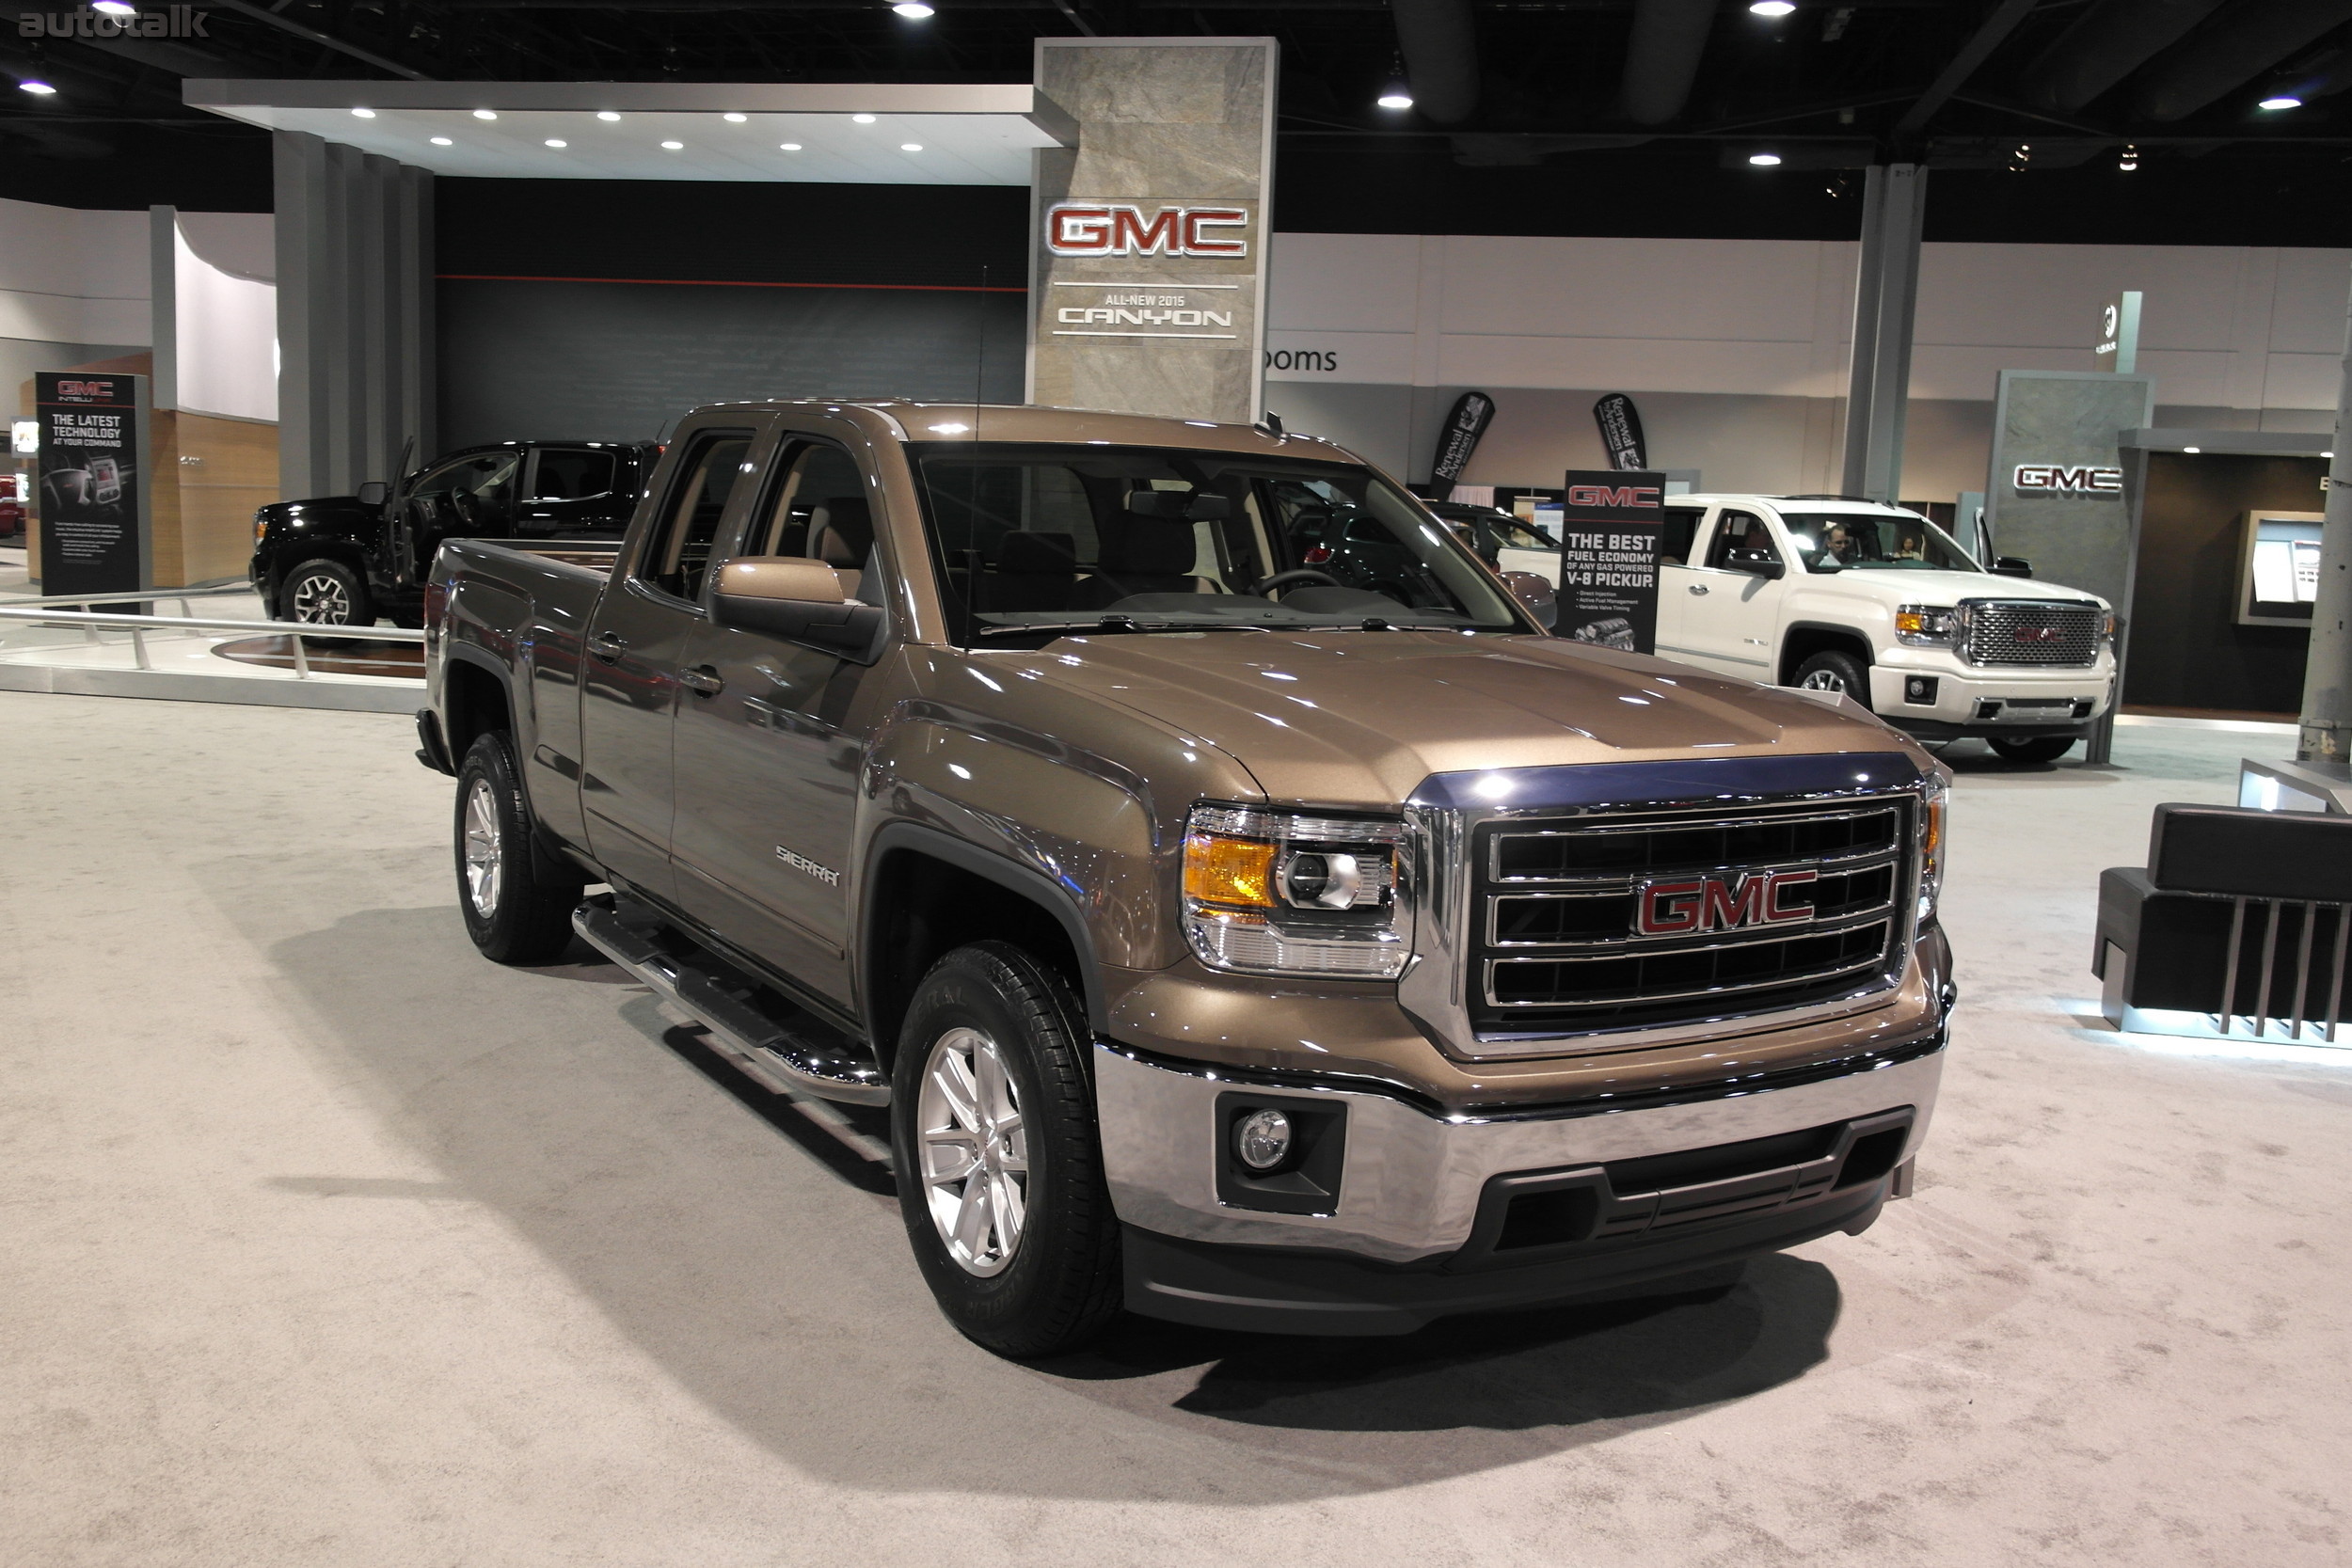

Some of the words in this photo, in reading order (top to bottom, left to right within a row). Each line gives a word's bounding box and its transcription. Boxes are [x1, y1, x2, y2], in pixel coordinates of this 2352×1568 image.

[1046, 204, 1248, 256] GMC
[1105, 294, 1156, 307] ALL-NEW
[1158, 295, 1184, 307] 2015
[1058, 308, 1232, 326] CANYON
[1265, 350, 1337, 371] oms
[57, 381, 113, 396] GMC
[52, 414, 74, 425] THE
[78, 415, 120, 427] LATEST
[1611, 397, 1636, 447] Renewal
[53, 426, 121, 438] TECHNOLOGY
[84, 439, 121, 448] COMMAND
[1435, 429, 1464, 477] Renewal
[2013, 465, 2122, 492] GMC
[1568, 485, 1660, 508] GMC
[1568, 533, 1604, 549] THE
[1608, 534, 1656, 551] BEST
[1567, 550, 1596, 562] FUEL
[1598, 551, 1654, 563] ECONOMY
[1566, 562, 1577, 570] OF
[1596, 572, 1654, 588] PICKUP.
[2014, 626, 2068, 642] GMC
[776, 845, 839, 887] SIERRA
[1637, 869, 1818, 935] GMC
